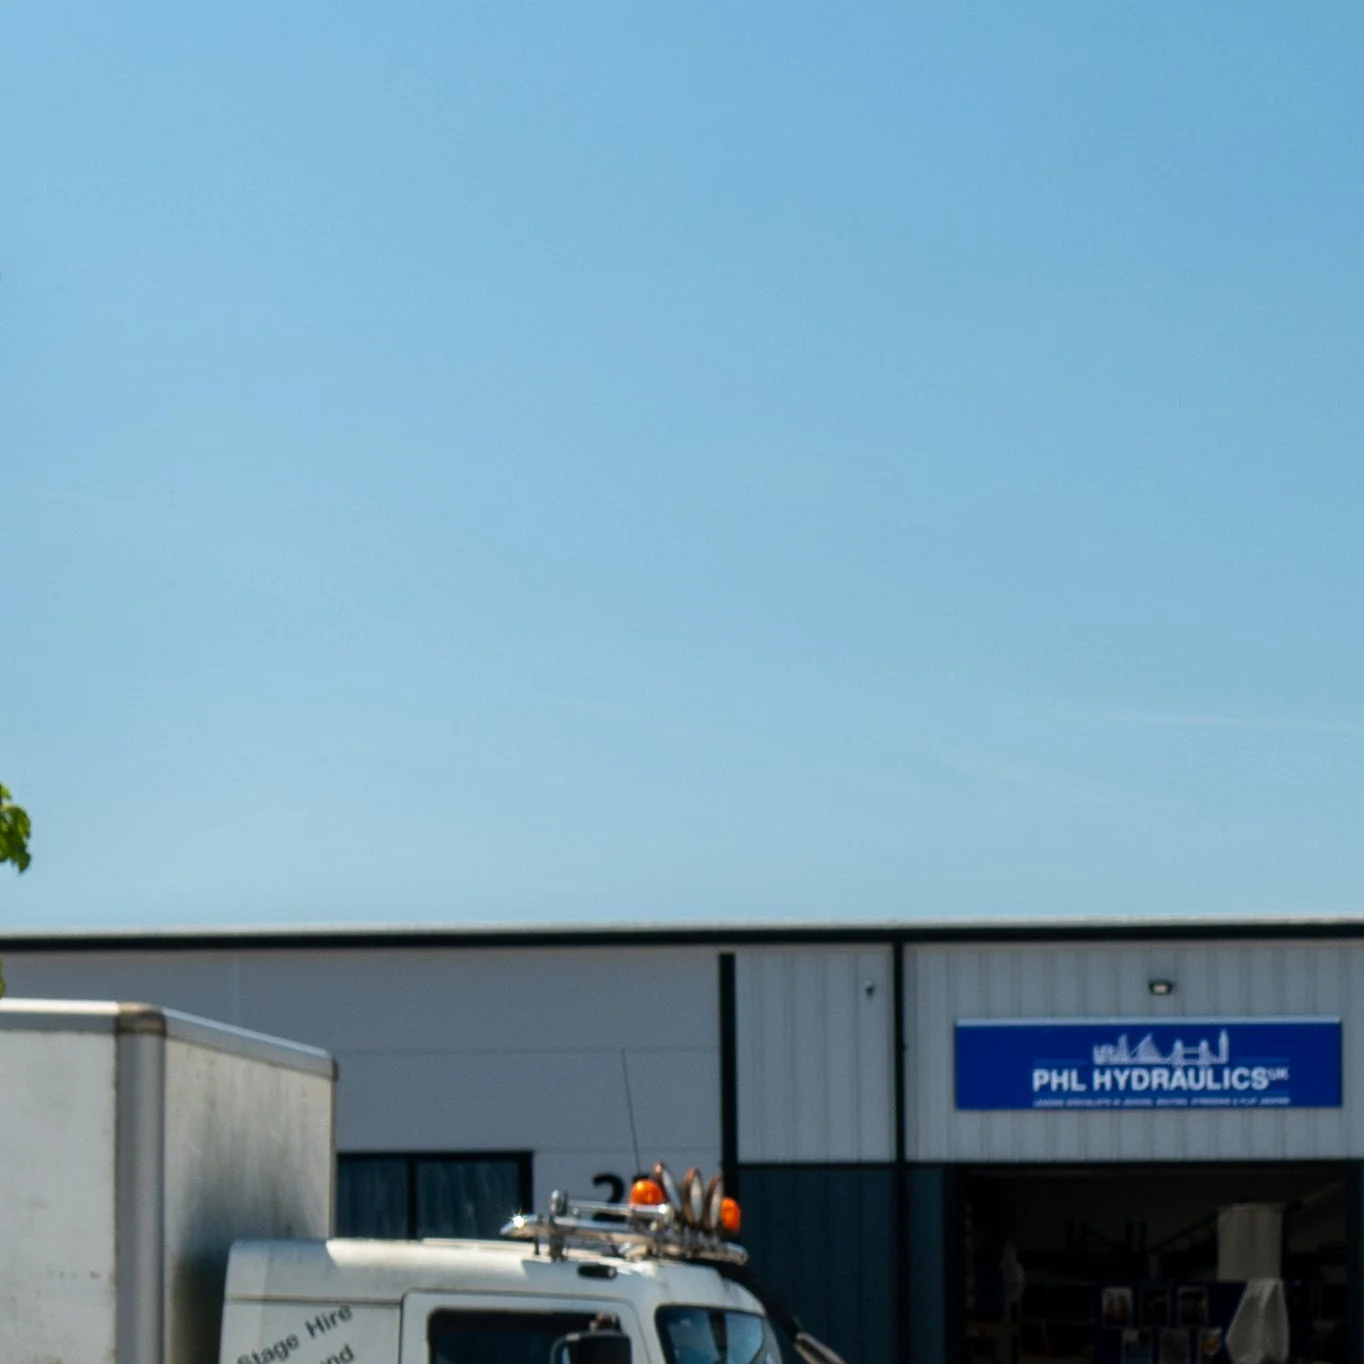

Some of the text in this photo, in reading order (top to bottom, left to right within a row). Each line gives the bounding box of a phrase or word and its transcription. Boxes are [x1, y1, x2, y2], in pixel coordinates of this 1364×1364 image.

[1032, 1068, 1087, 1092] PHL
[1093, 1066, 1269, 1092] HYDRAULICS
[305, 1305, 353, 1339] Hire
